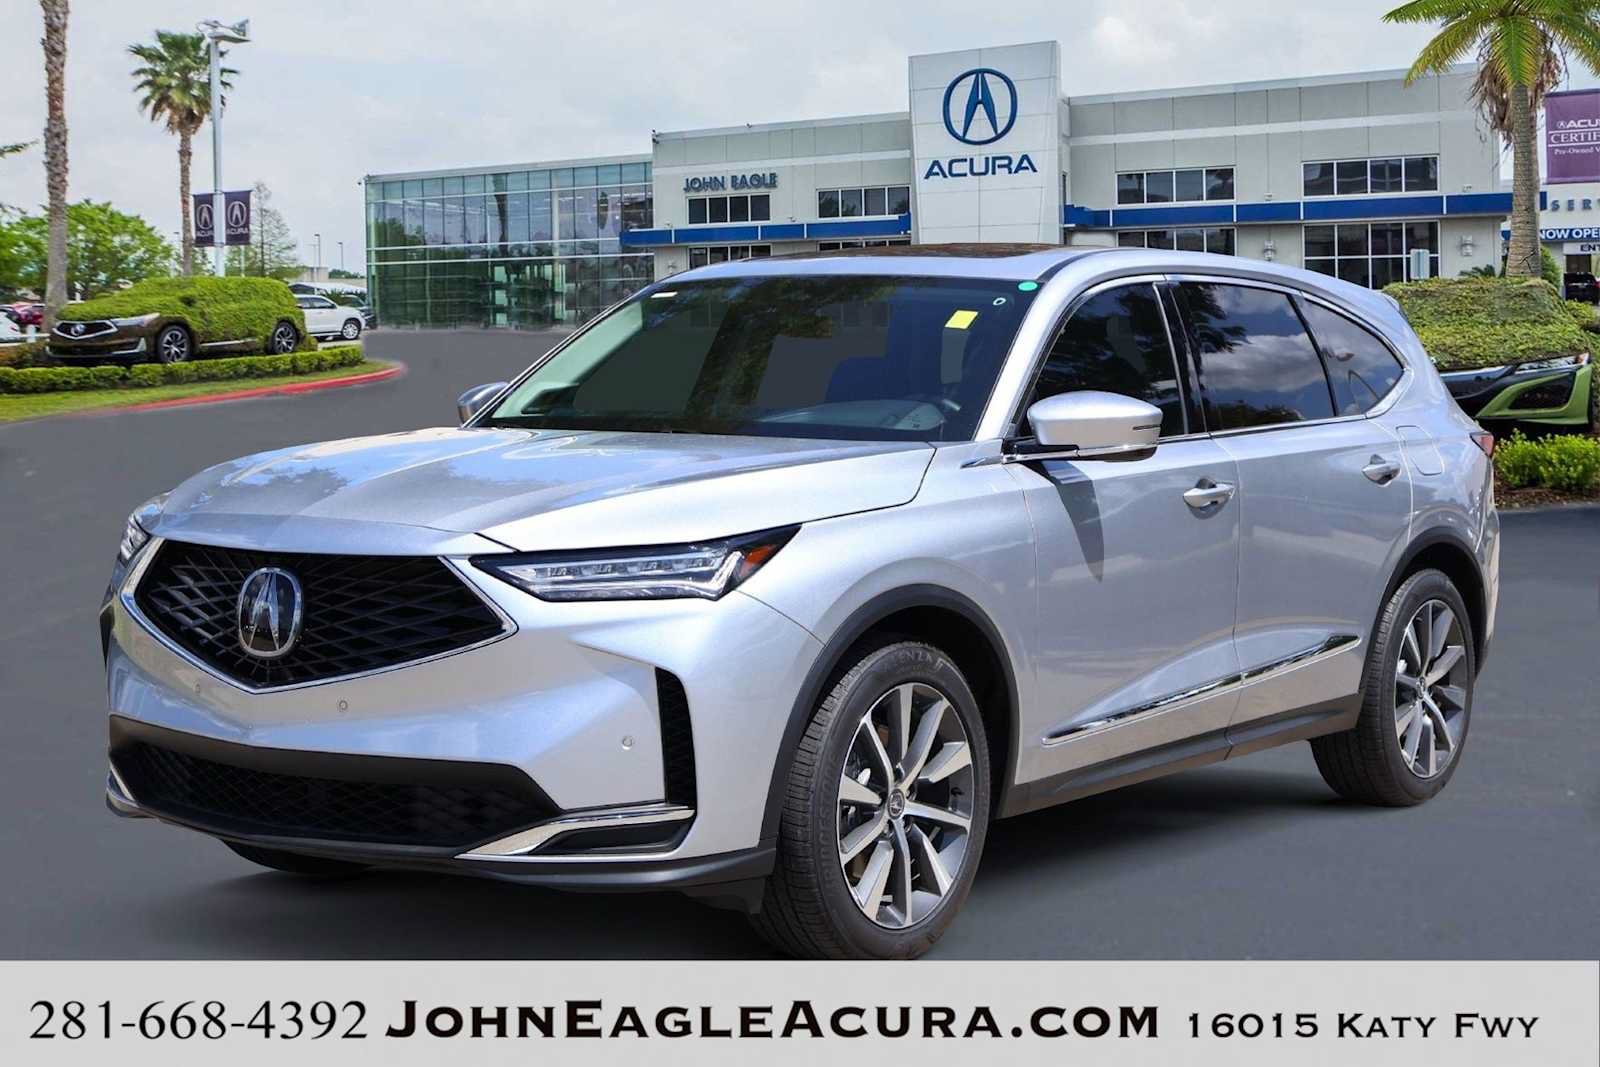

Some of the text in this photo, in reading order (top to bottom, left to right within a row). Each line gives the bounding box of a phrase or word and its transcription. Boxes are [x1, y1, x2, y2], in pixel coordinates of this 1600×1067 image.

[1566, 119, 1600, 128] ACU
[923, 153, 1038, 180] ACURA
[683, 172, 777, 192] JOHN EAGLE
[226, 227, 249, 235] ACURA
[1539, 228, 1600, 239] NOW OPE
